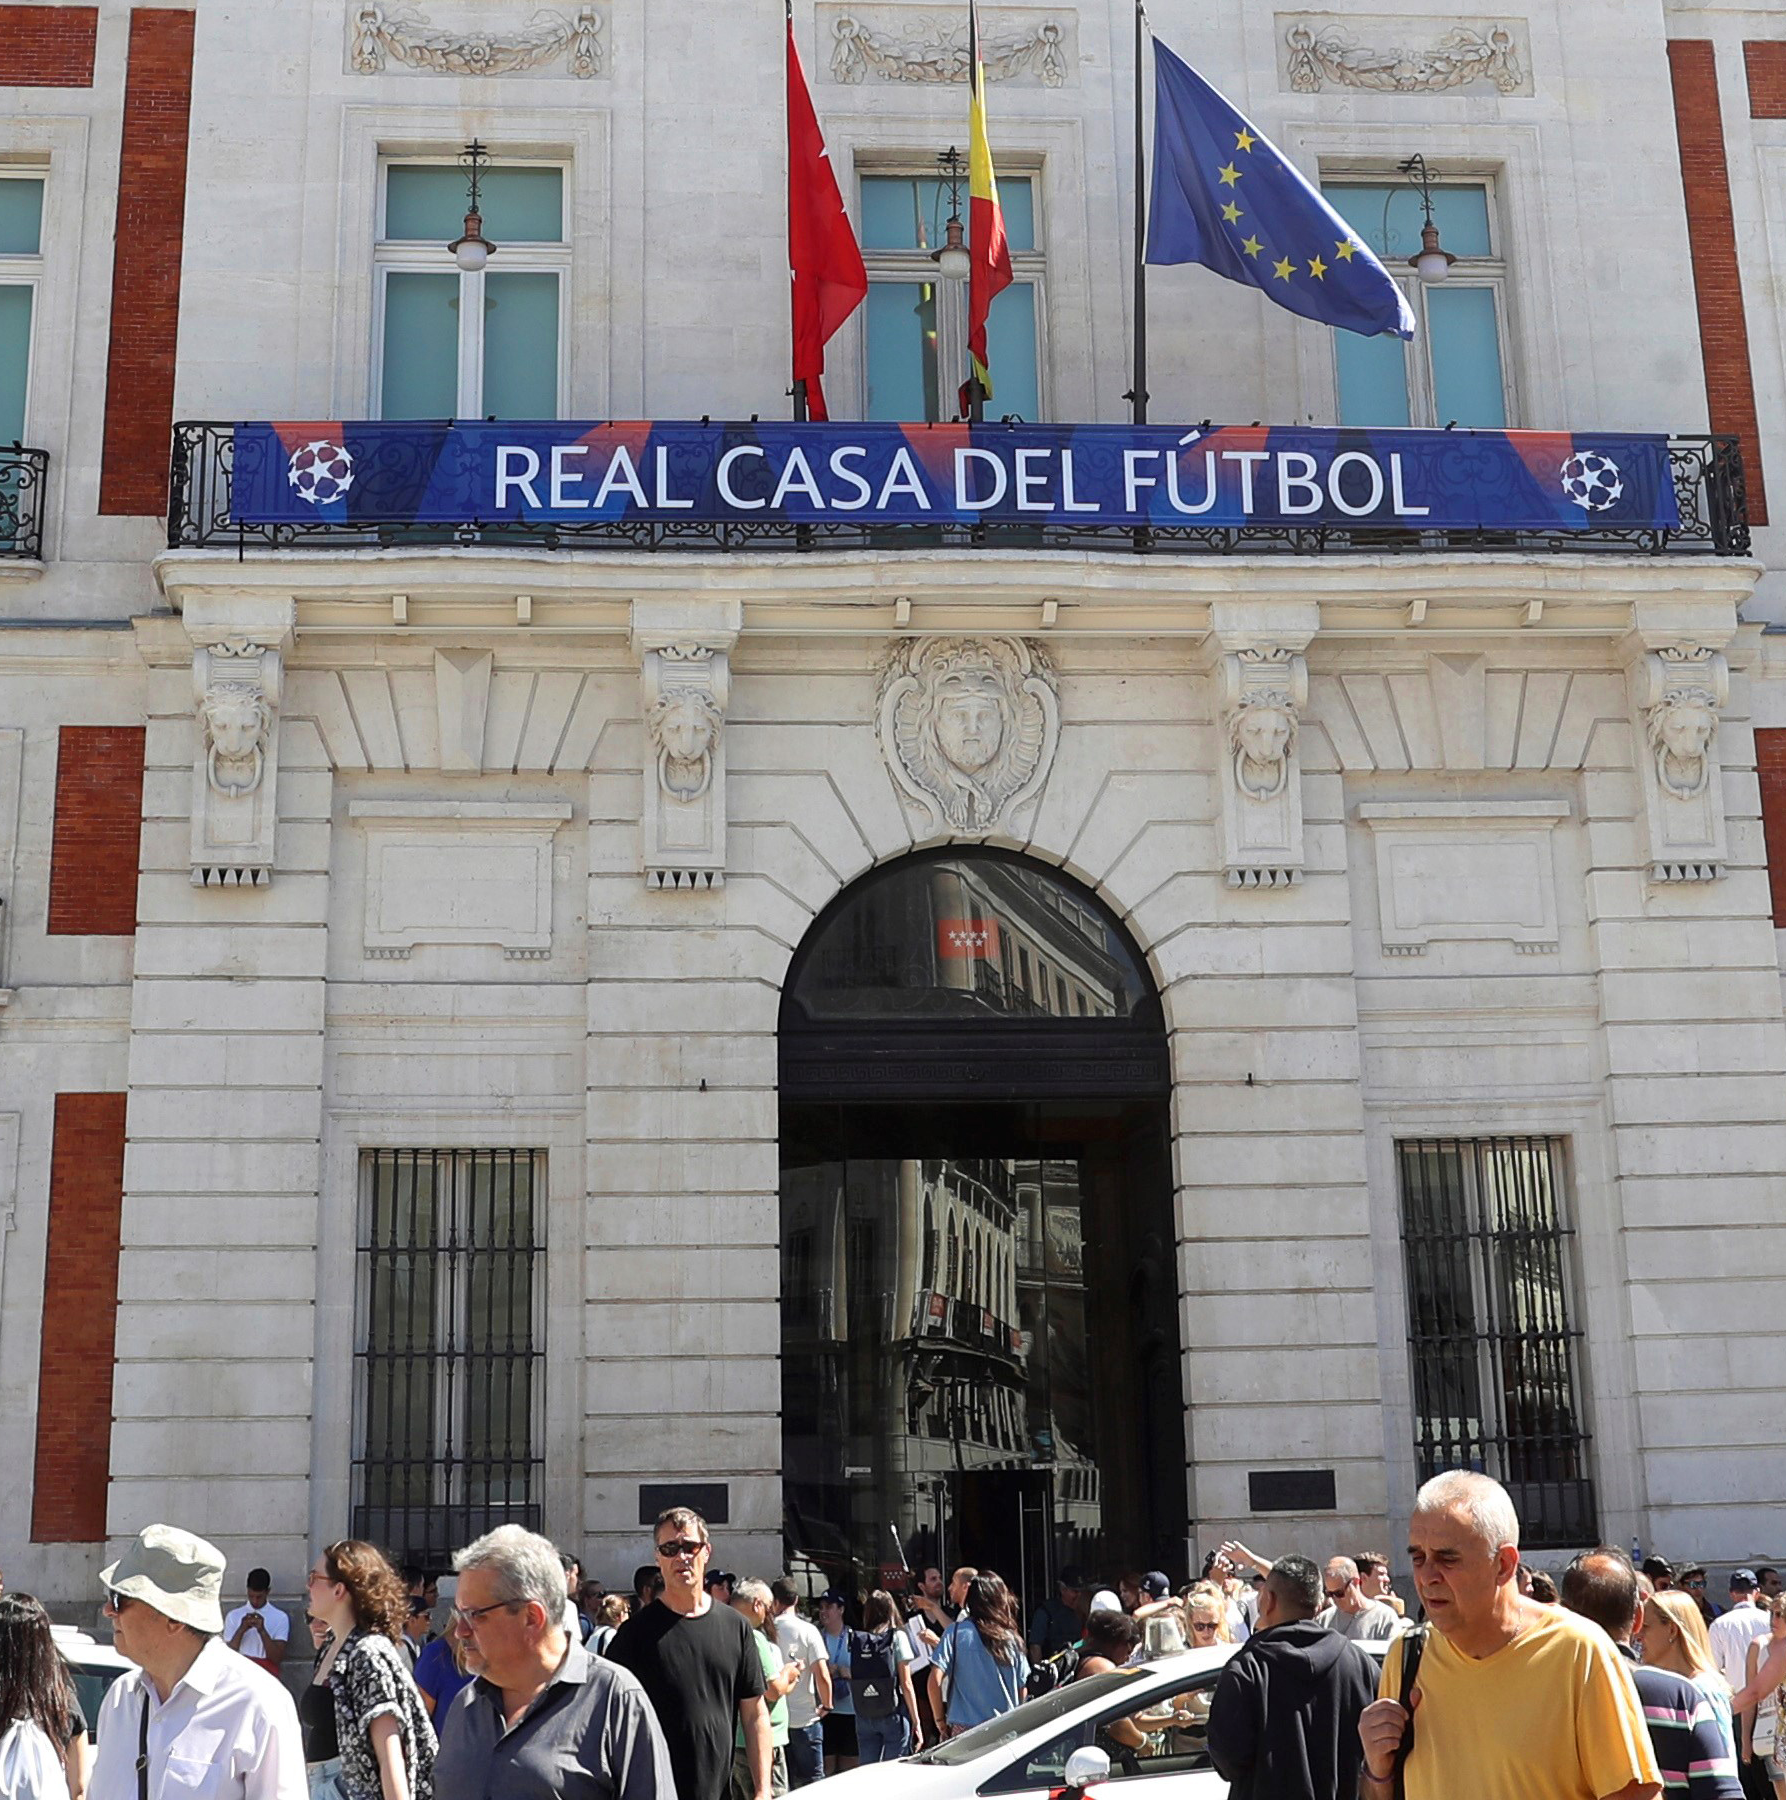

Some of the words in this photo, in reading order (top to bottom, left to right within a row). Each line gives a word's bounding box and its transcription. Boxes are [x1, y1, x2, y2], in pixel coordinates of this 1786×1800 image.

[495, 444, 694, 510] REAL
[716, 444, 931, 511] CASA
[953, 447, 1100, 512] DEL
[1123, 430, 1430, 517] FÚTBOL
